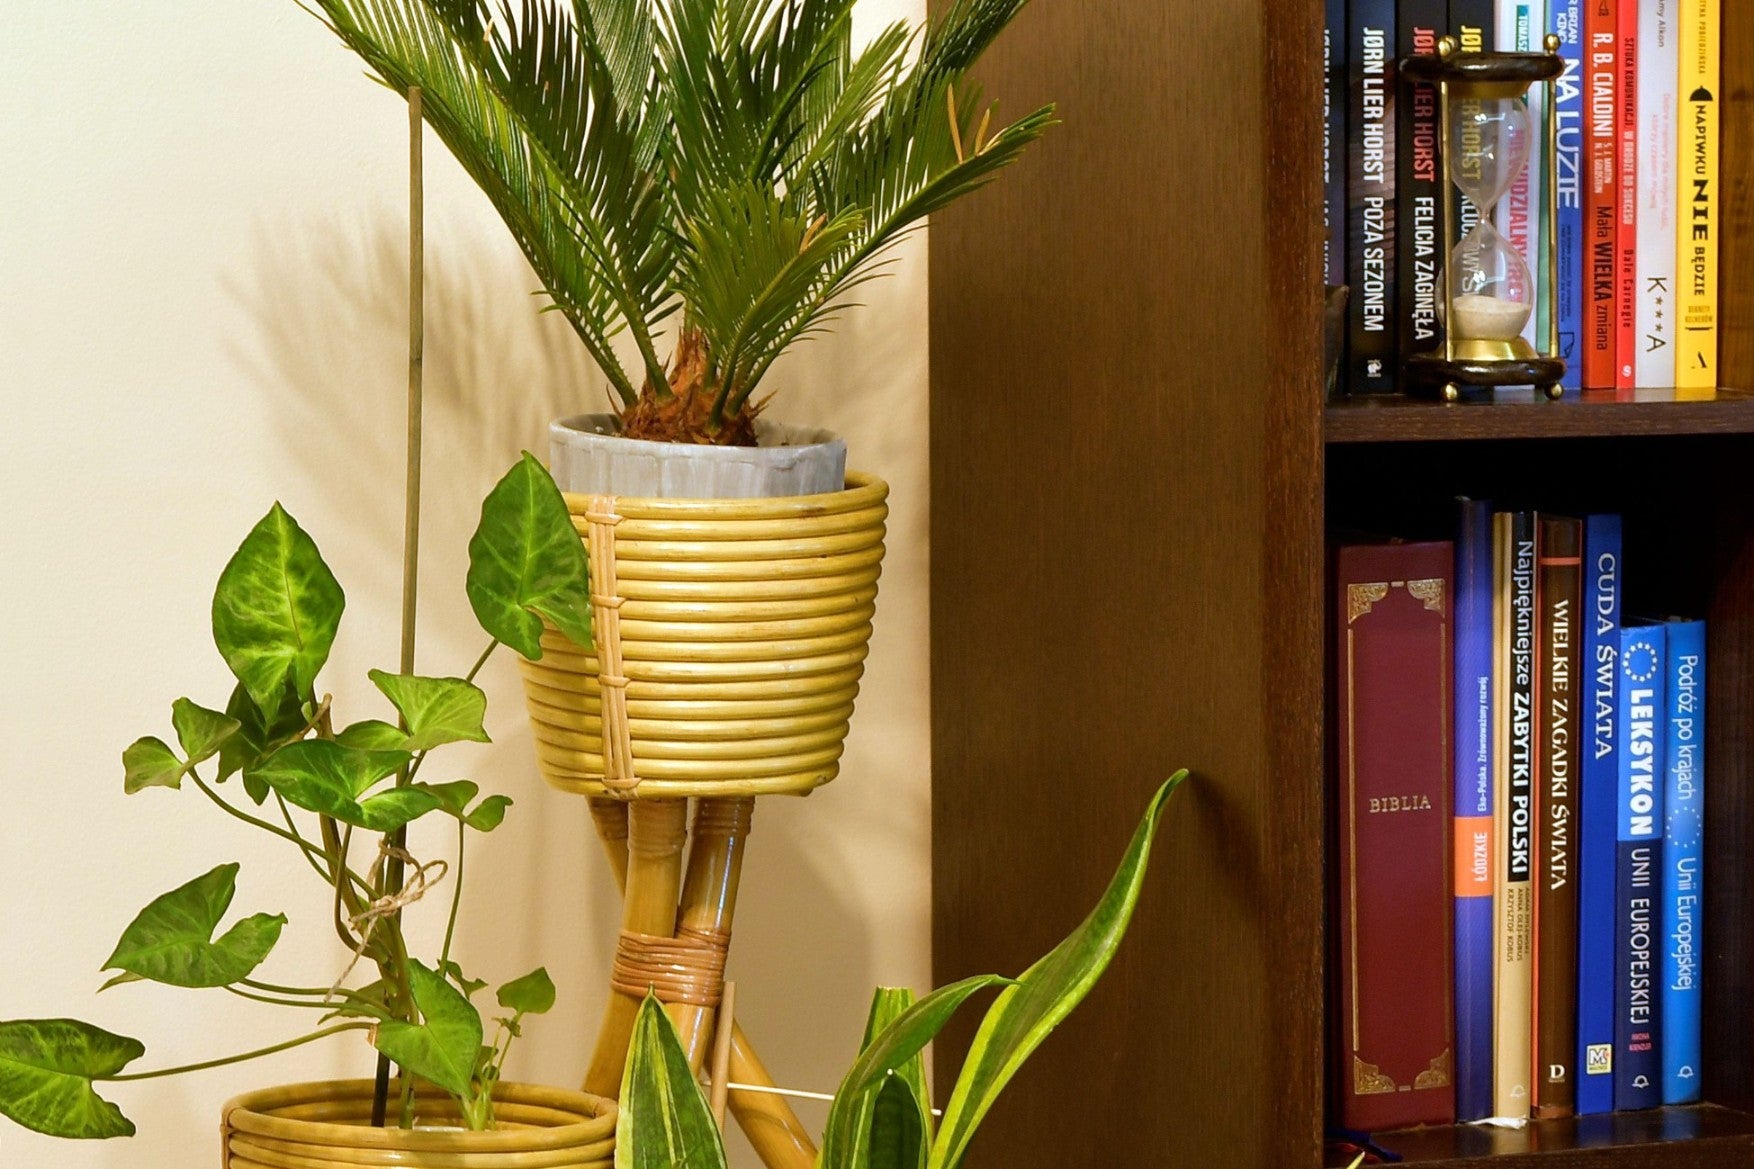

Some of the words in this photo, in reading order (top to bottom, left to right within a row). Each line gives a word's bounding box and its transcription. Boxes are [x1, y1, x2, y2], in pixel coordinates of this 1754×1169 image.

[1363, 27, 1384, 73] JØRN
[1413, 27, 1434, 56] JØR
[1517, 14, 1528, 51] TOMASZ
[1567, 6, 1578, 44] BRIAN
[1593, 33, 1613, 48] R.
[1656, 20, 1666, 48] Alkon
[1593, 53, 1613, 68] B.
[1623, 37, 1634, 68] SZTUKA
[1363, 78, 1384, 118] LIER
[1555, 58, 1580, 103] NA
[1592, 72, 1613, 137] CIALDINI
[1363, 123, 1384, 184] HORST
[1413, 123, 1435, 182] HORST
[1462, 123, 1482, 180] HORST
[1555, 111, 1580, 209] LUZIE
[1623, 141, 1633, 172] DRODZE
[1624, 130, 1633, 140] W
[1695, 104, 1707, 175] NAPIWKU
[1594, 158, 1603, 194] GOLDSTEIN
[1604, 157, 1612, 184] MARTIN
[1623, 174, 1633, 186] DO
[1363, 196, 1384, 244] POZA
[1415, 196, 1434, 256] FELICIA
[1596, 206, 1613, 238] Mała
[1622, 188, 1633, 225] SUKCESU
[1692, 179, 1709, 241] NIE
[1593, 241, 1613, 302] WIELKA
[1623, 249, 1634, 273] Dale
[1690, 246, 1706, 296] BĘDZIE
[1363, 248, 1384, 331] SEZONEM
[1411, 260, 1434, 340] ZAGINĘŁA
[1621, 278, 1634, 328] Carnegie
[1595, 304, 1612, 351] zmiana
[1512, 541, 1534, 686] Najpiękniejsze
[1597, 552, 1616, 637] CUDA
[1551, 598, 1569, 693] WIELKIE
[1594, 645, 1618, 760] ŚWIATA
[1677, 654, 1699, 714] Podróż
[1512, 692, 1530, 787] ZABYTKI
[1551, 698, 1569, 798] ZAGADKI
[1671, 717, 1694, 741] po
[1629, 688, 1654, 836] LEKSYKON
[1671, 744, 1697, 800] krajach
[1369, 795, 1432, 813] BIBLIA
[1471, 832, 1488, 882] ŁÓDZKIE
[1511, 795, 1529, 873] POLSKI
[1550, 803, 1571, 891] ŚWIATA
[1630, 848, 1651, 887] UNII
[1677, 857, 1697, 891] Unii
[1629, 898, 1650, 1024] EUROPEJSKIEJ
[1671, 895, 1697, 991] Europejskiej
